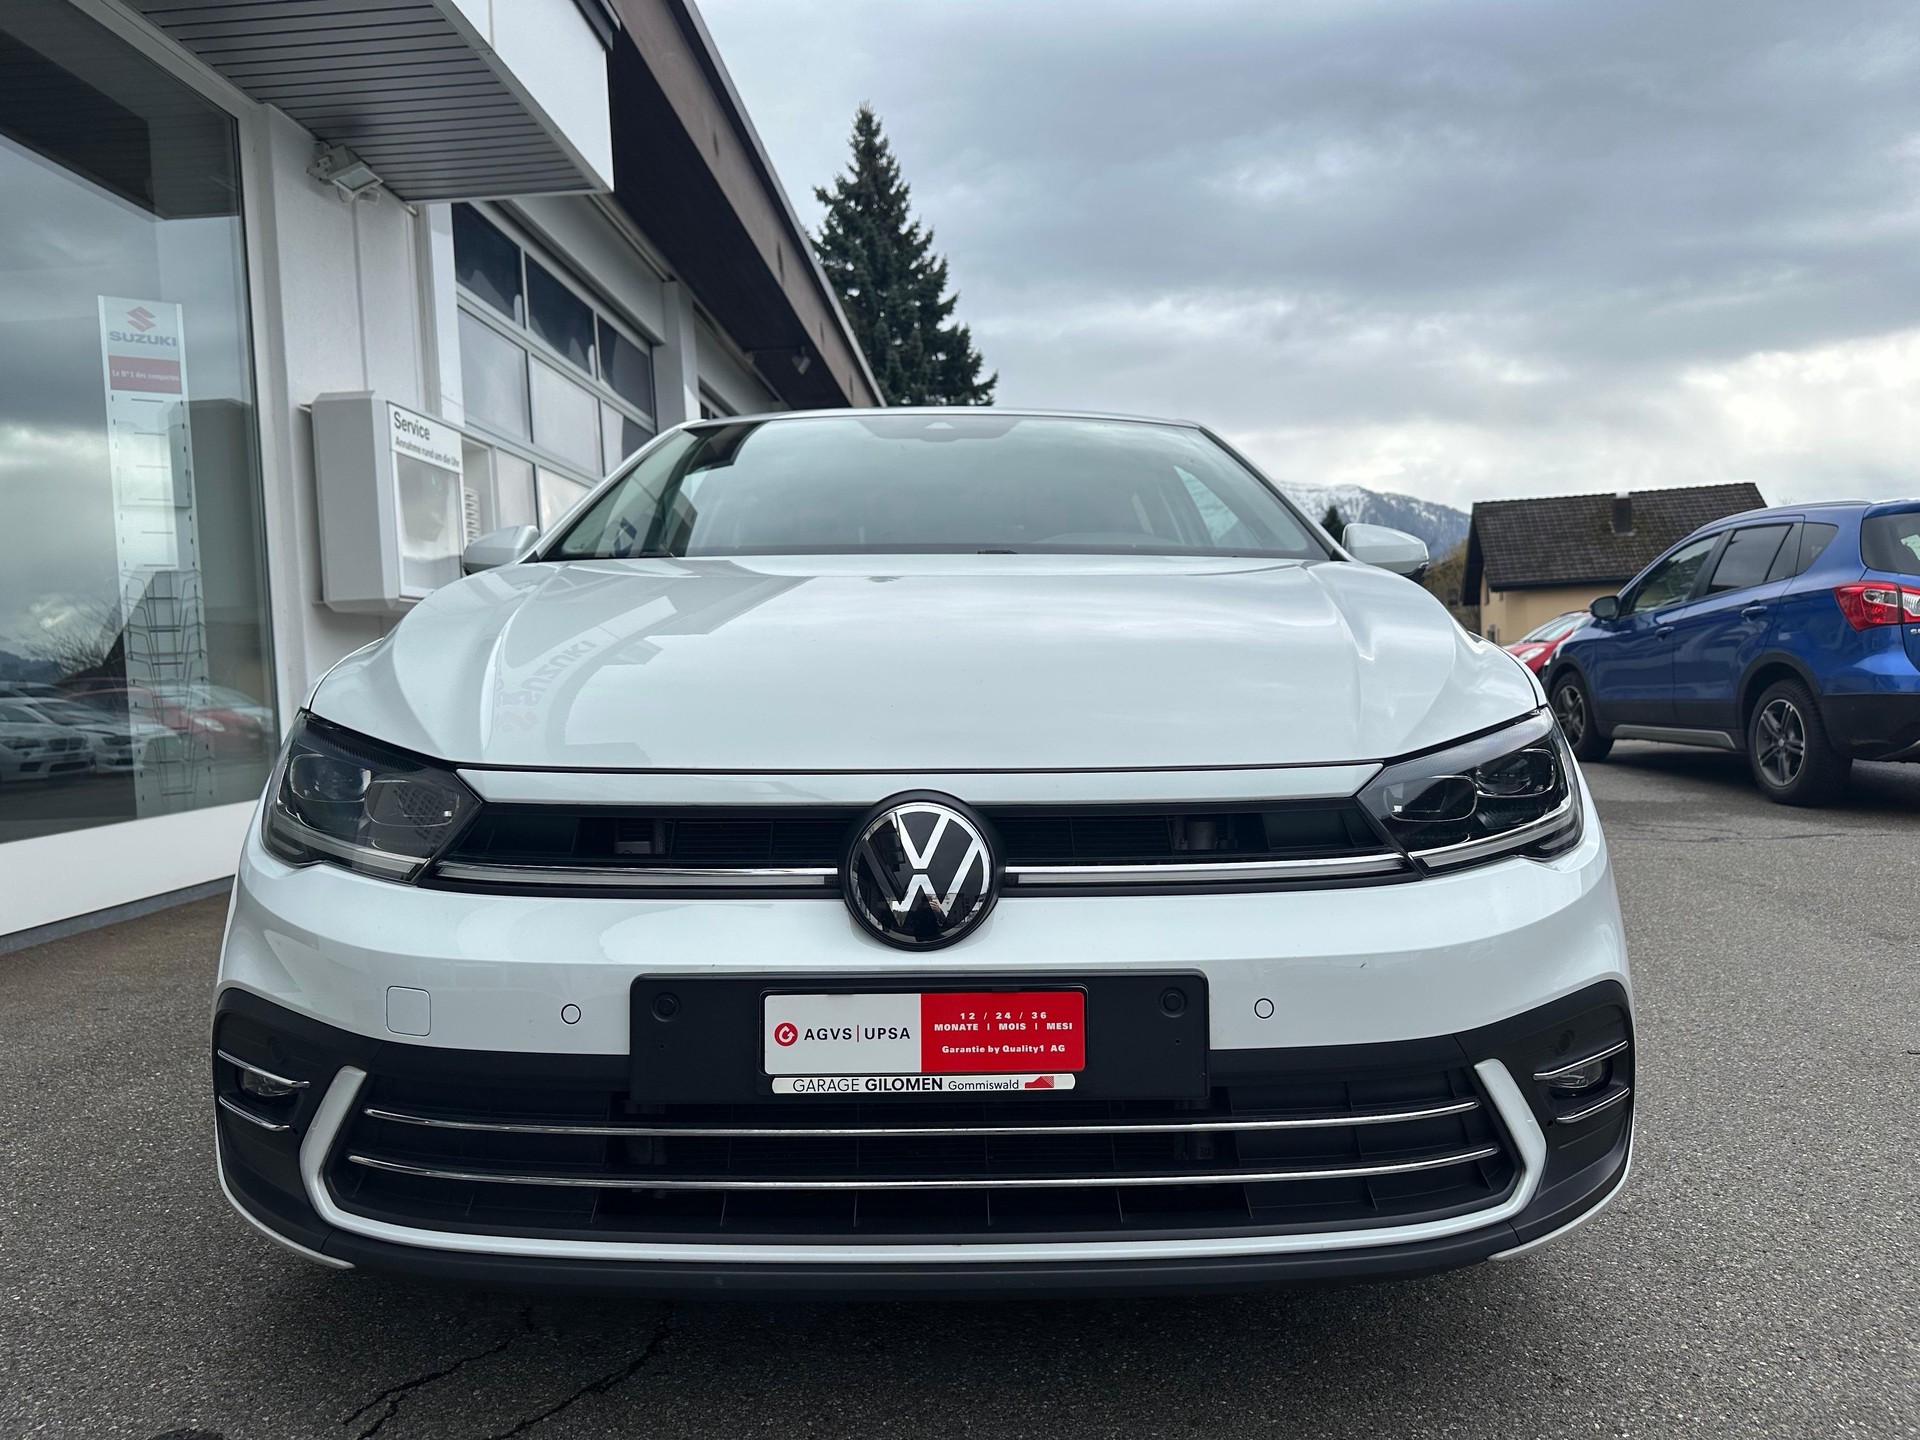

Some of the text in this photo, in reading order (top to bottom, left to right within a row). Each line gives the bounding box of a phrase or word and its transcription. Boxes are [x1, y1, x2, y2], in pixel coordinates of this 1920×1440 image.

[109, 331, 177, 347] SUZUKI
[394, 411, 430, 440] Service
[422, 447, 434, 459] rund
[960, 1012, 976, 1020] 12
[995, 1012, 1012, 1020] 24
[1031, 1011, 1047, 1019] 36
[934, 1023, 979, 1031] MONATE
[998, 1022, 1027, 1030] MOIS
[1046, 1022, 1073, 1030] MESI
[942, 1044, 1065, 1055] Garantie by Quality1 AG
[793, 1078, 1019, 1092] GARAGE GILOMEN Gommiswald
